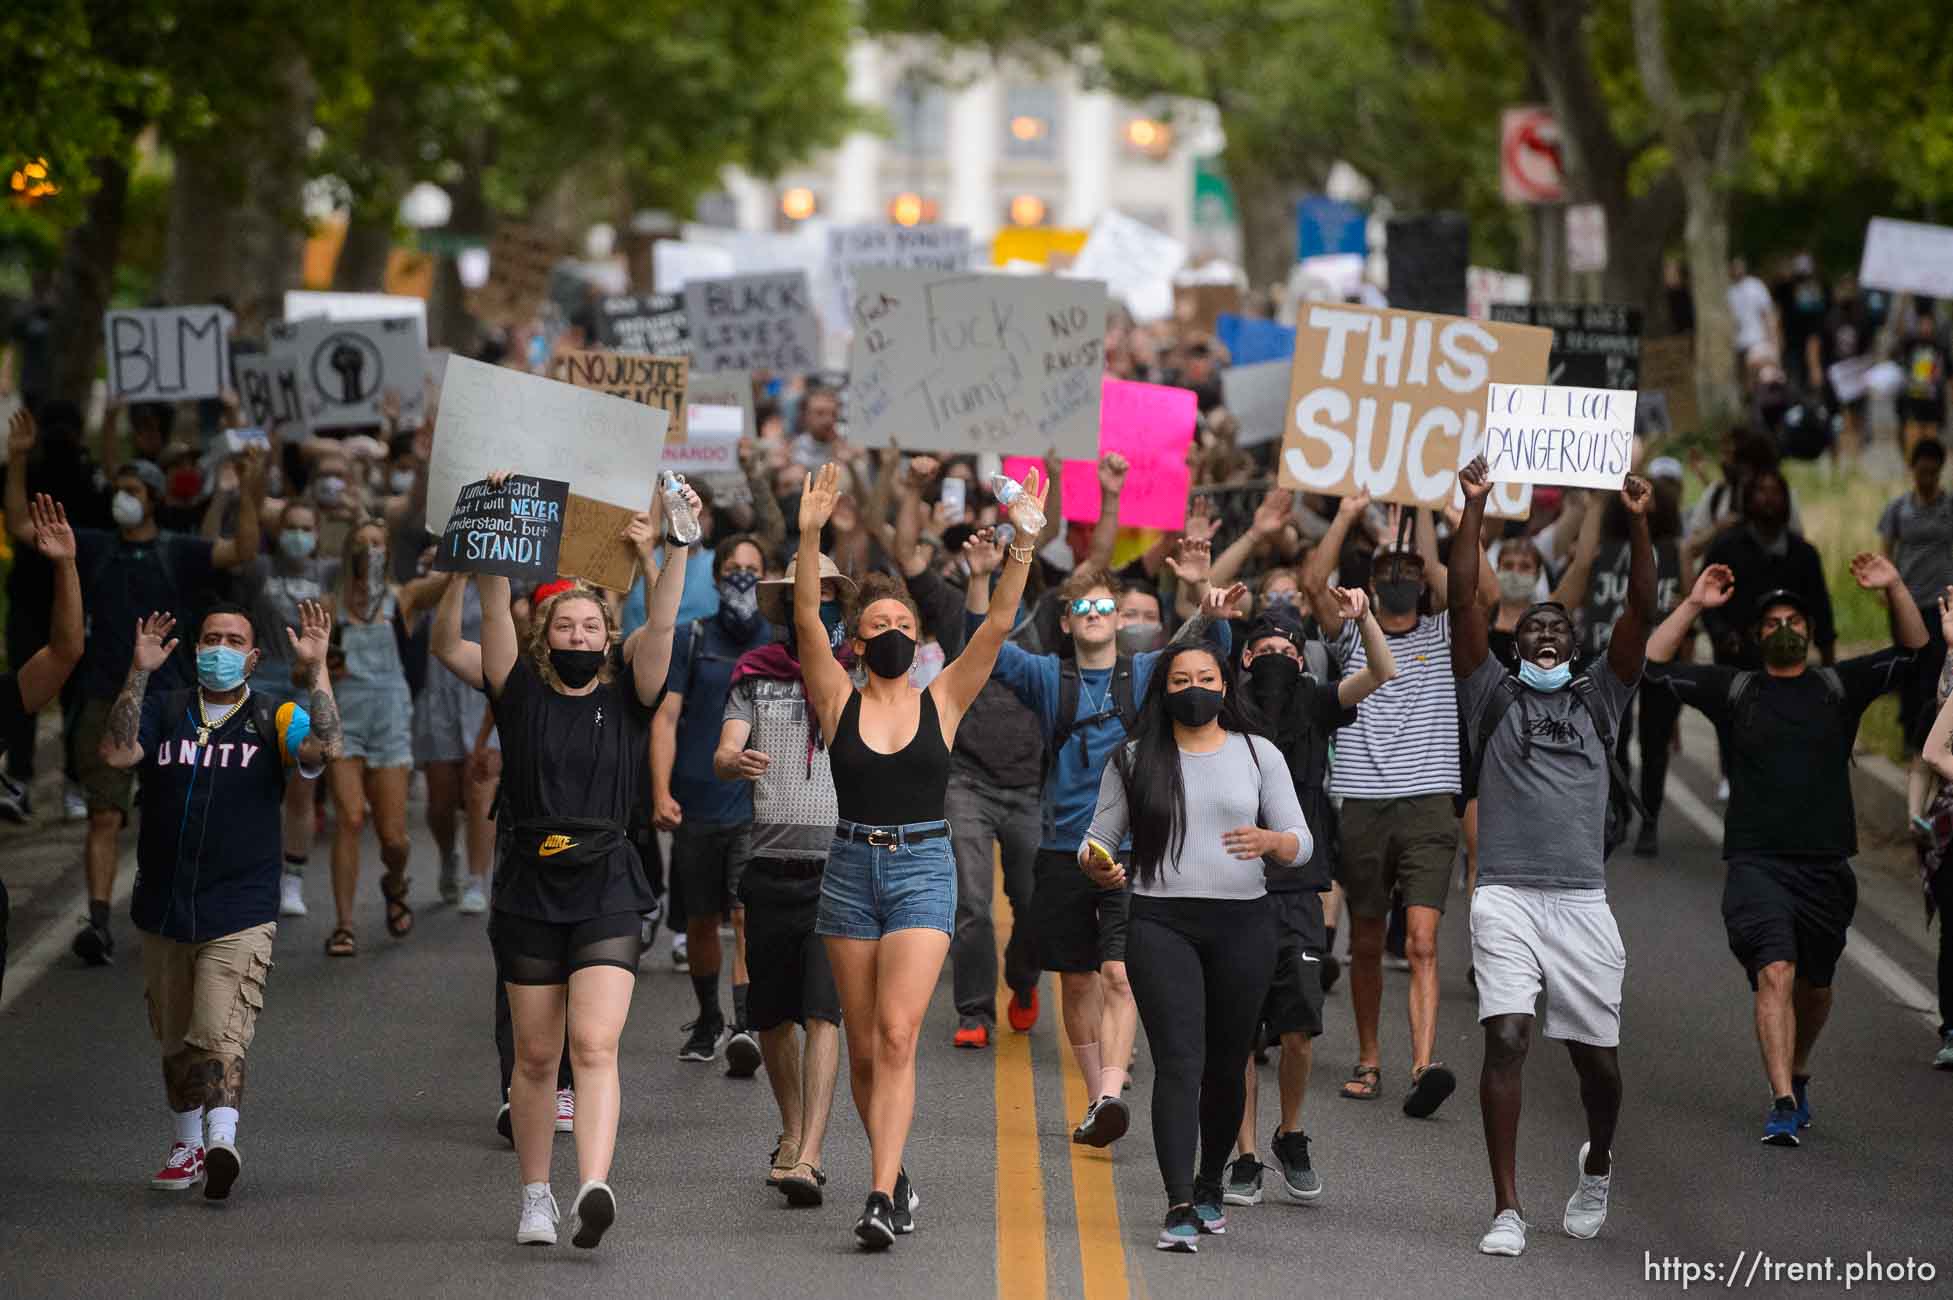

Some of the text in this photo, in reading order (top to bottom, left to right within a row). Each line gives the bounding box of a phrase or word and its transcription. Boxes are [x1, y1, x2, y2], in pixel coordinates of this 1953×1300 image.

[704, 280, 804, 317] BLACK
[703, 319, 798, 351] LIVES
[923, 275, 1033, 360] Fuck
[1046, 304, 1089, 338] NO
[112, 312, 224, 393] BLM
[1309, 306, 1499, 393] THIS
[567, 354, 684, 389] NO JUSTICE
[242, 369, 303, 425] BLM
[1486, 427, 1634, 475] DANGEROUS?
[465, 480, 540, 500] undestand
[455, 501, 472, 515] hat
[483, 497, 505, 511] will
[511, 498, 560, 522] NEVER
[521, 521, 549, 537] but
[451, 533, 459, 558] I
[466, 530, 542, 566] STAND!
[157, 739, 259, 768] UNITY
[543, 834, 573, 848] NIKE
